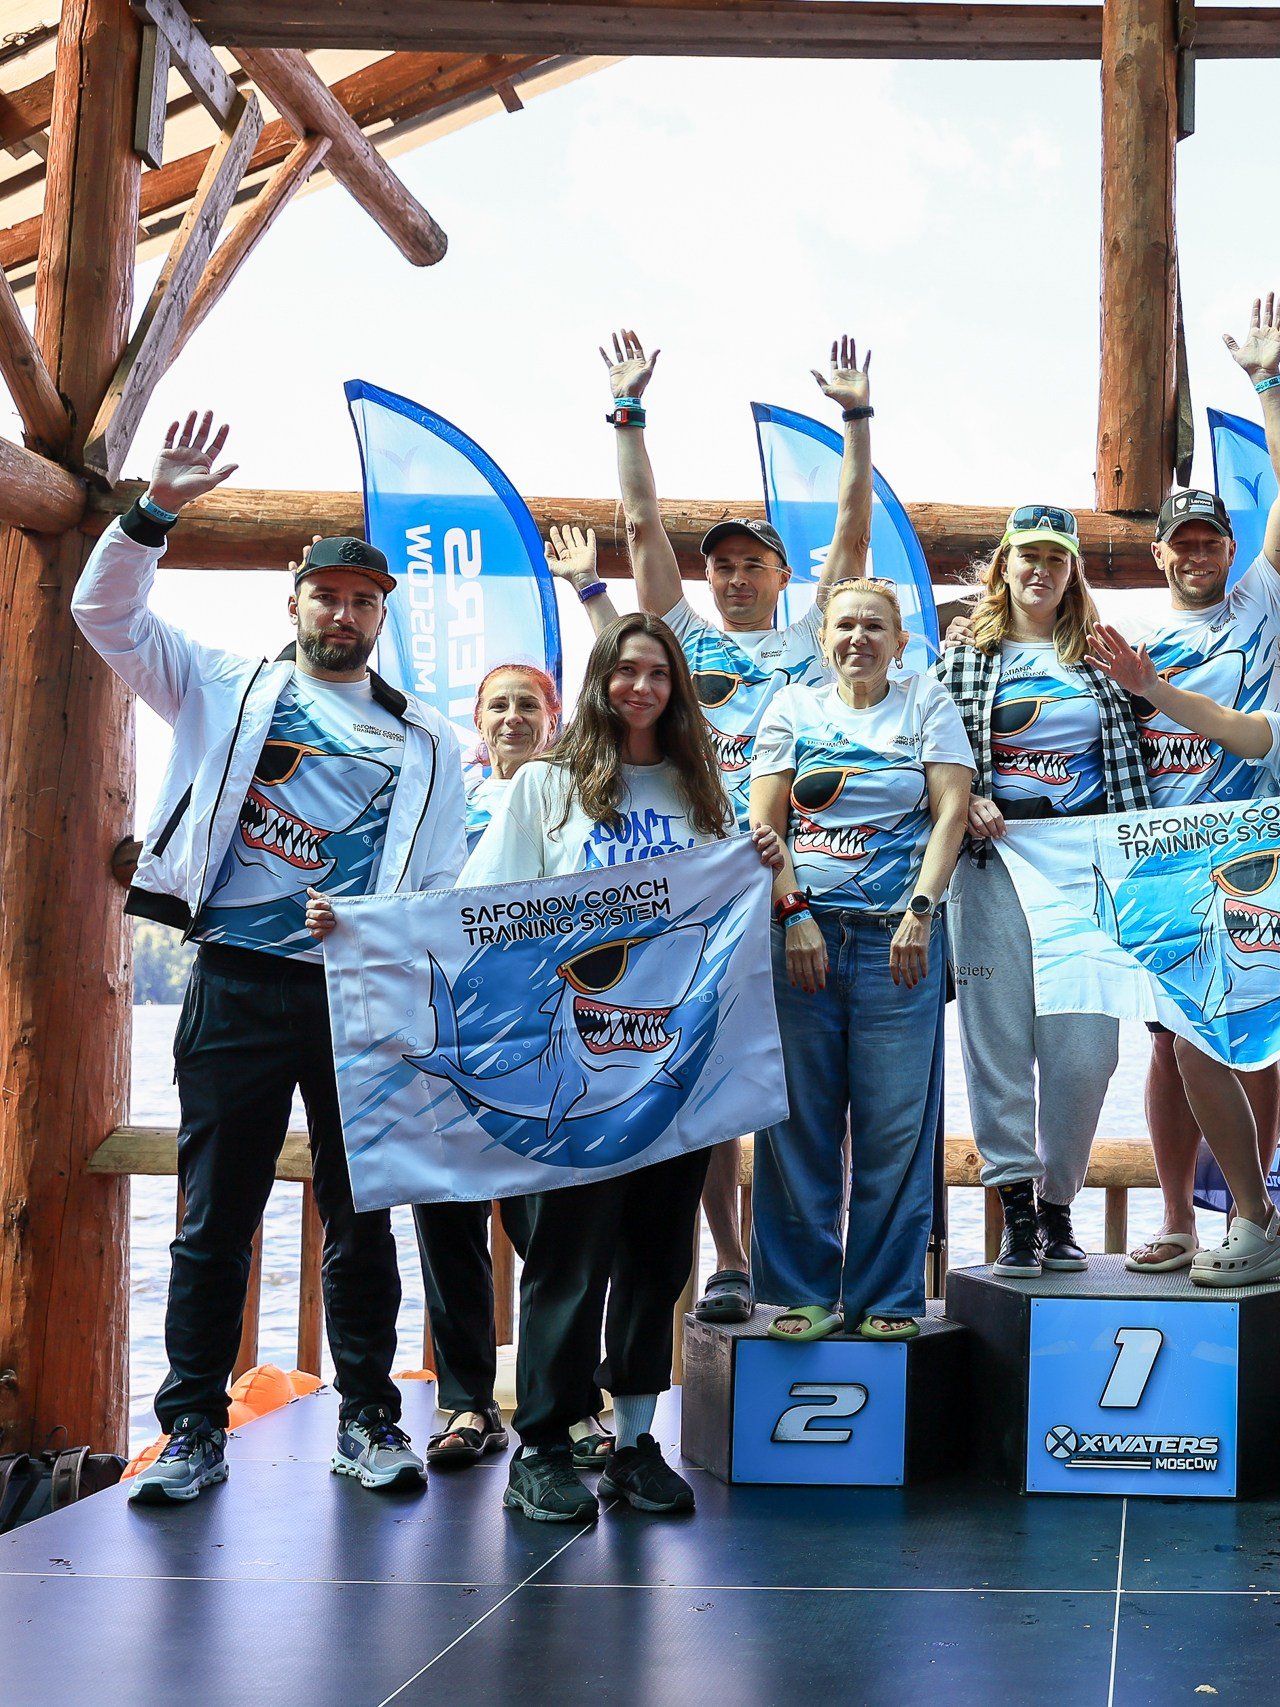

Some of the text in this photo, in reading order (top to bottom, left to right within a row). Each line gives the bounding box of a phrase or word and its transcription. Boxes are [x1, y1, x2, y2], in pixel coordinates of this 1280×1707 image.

[1117, 811, 1235, 841] SAFONOV
[1119, 828, 1229, 860] TRAINING
[460, 877, 669, 926] SAFONOV COACH
[463, 897, 671, 946] TRAINING SYSTEM
[955, 963, 994, 979] ciety
[1099, 1327, 1164, 1408] 1
[770, 1382, 869, 1443] 2
[1155, 1457, 1218, 1472] MOSCOW
